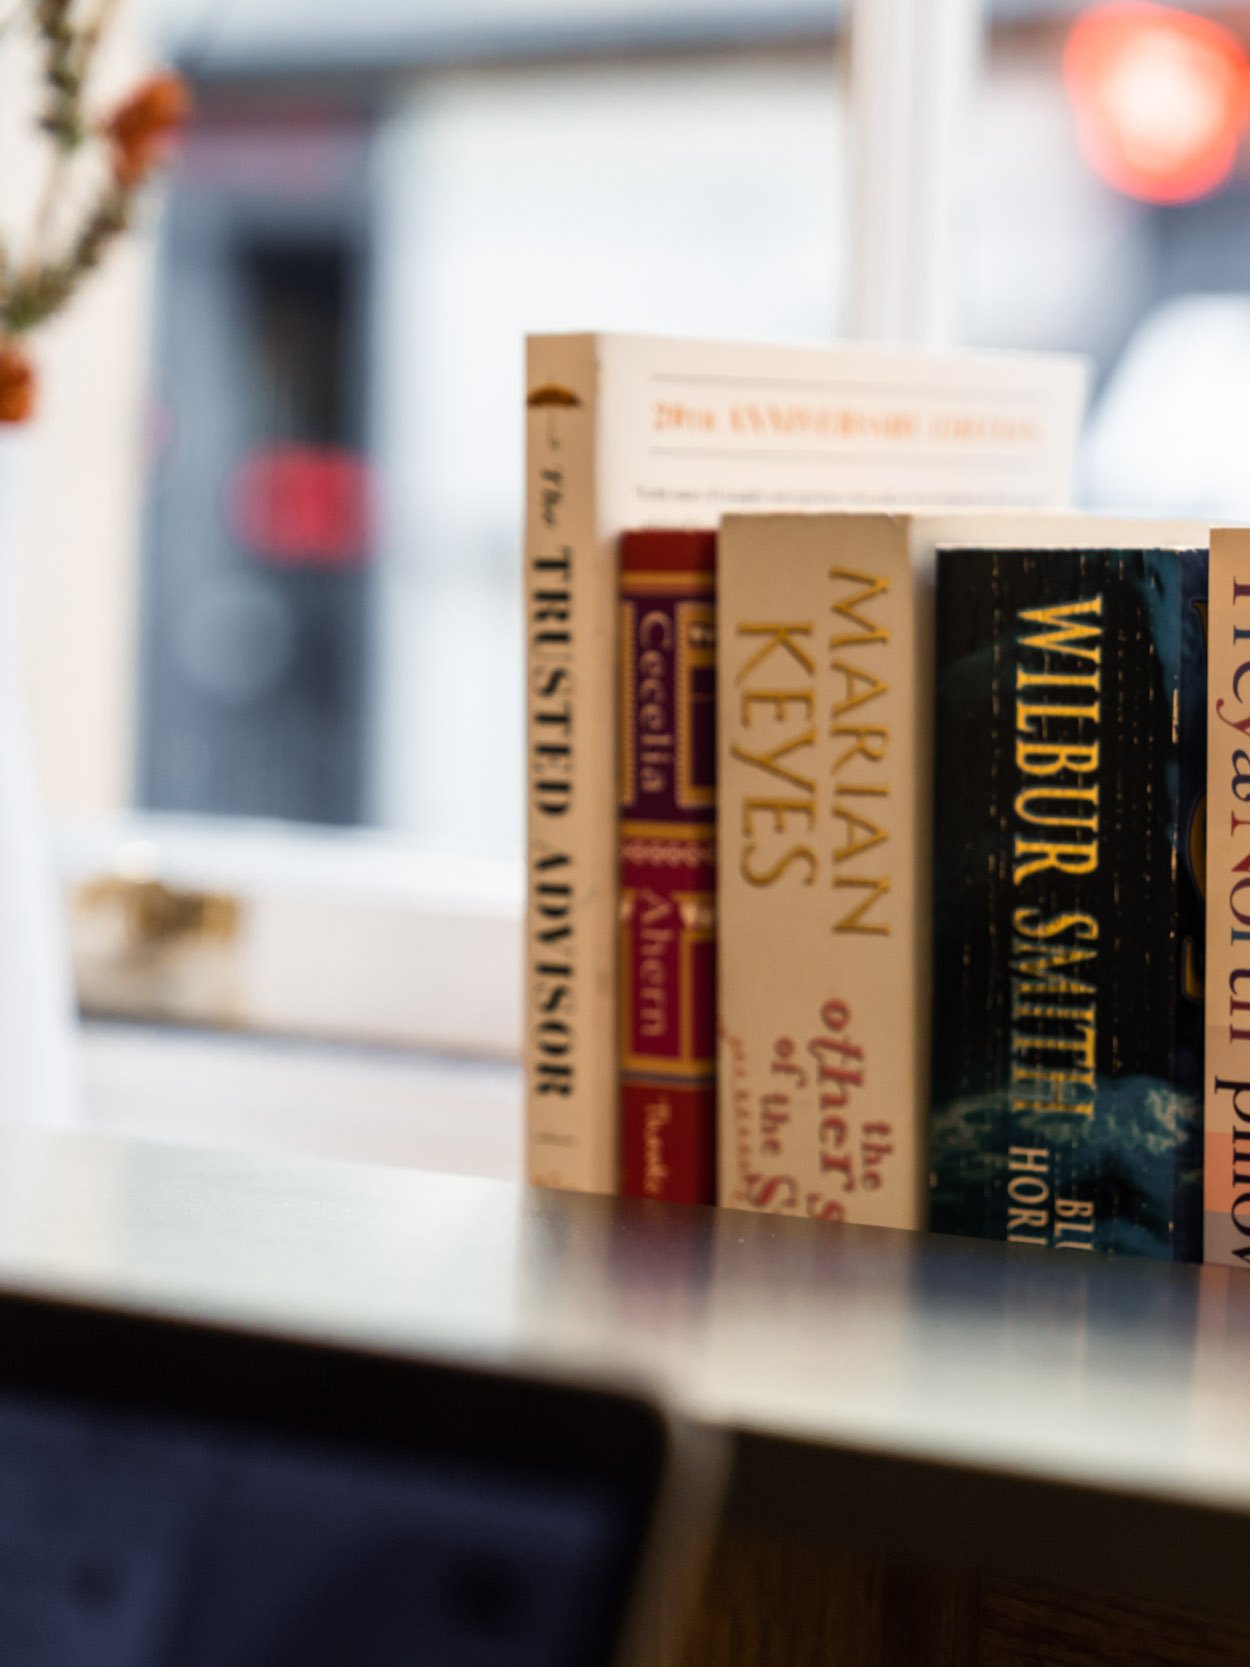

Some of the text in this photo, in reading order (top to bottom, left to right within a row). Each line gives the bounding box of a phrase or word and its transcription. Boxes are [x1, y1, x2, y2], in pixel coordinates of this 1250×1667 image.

[533, 545, 572, 817] TRUSTED
[730, 620, 820, 889] KEYES
[828, 566, 891, 938] MARIAN
[638, 609, 674, 1038] Cecelia Ahern
[1011, 593, 1103, 1121] WILBUR SMITH
[535, 842, 575, 1099] ADVISOR
[771, 1037, 807, 1089] of
[808, 998, 864, 1192] other
[760, 1094, 790, 1156] the
[862, 1120, 894, 1191] the
